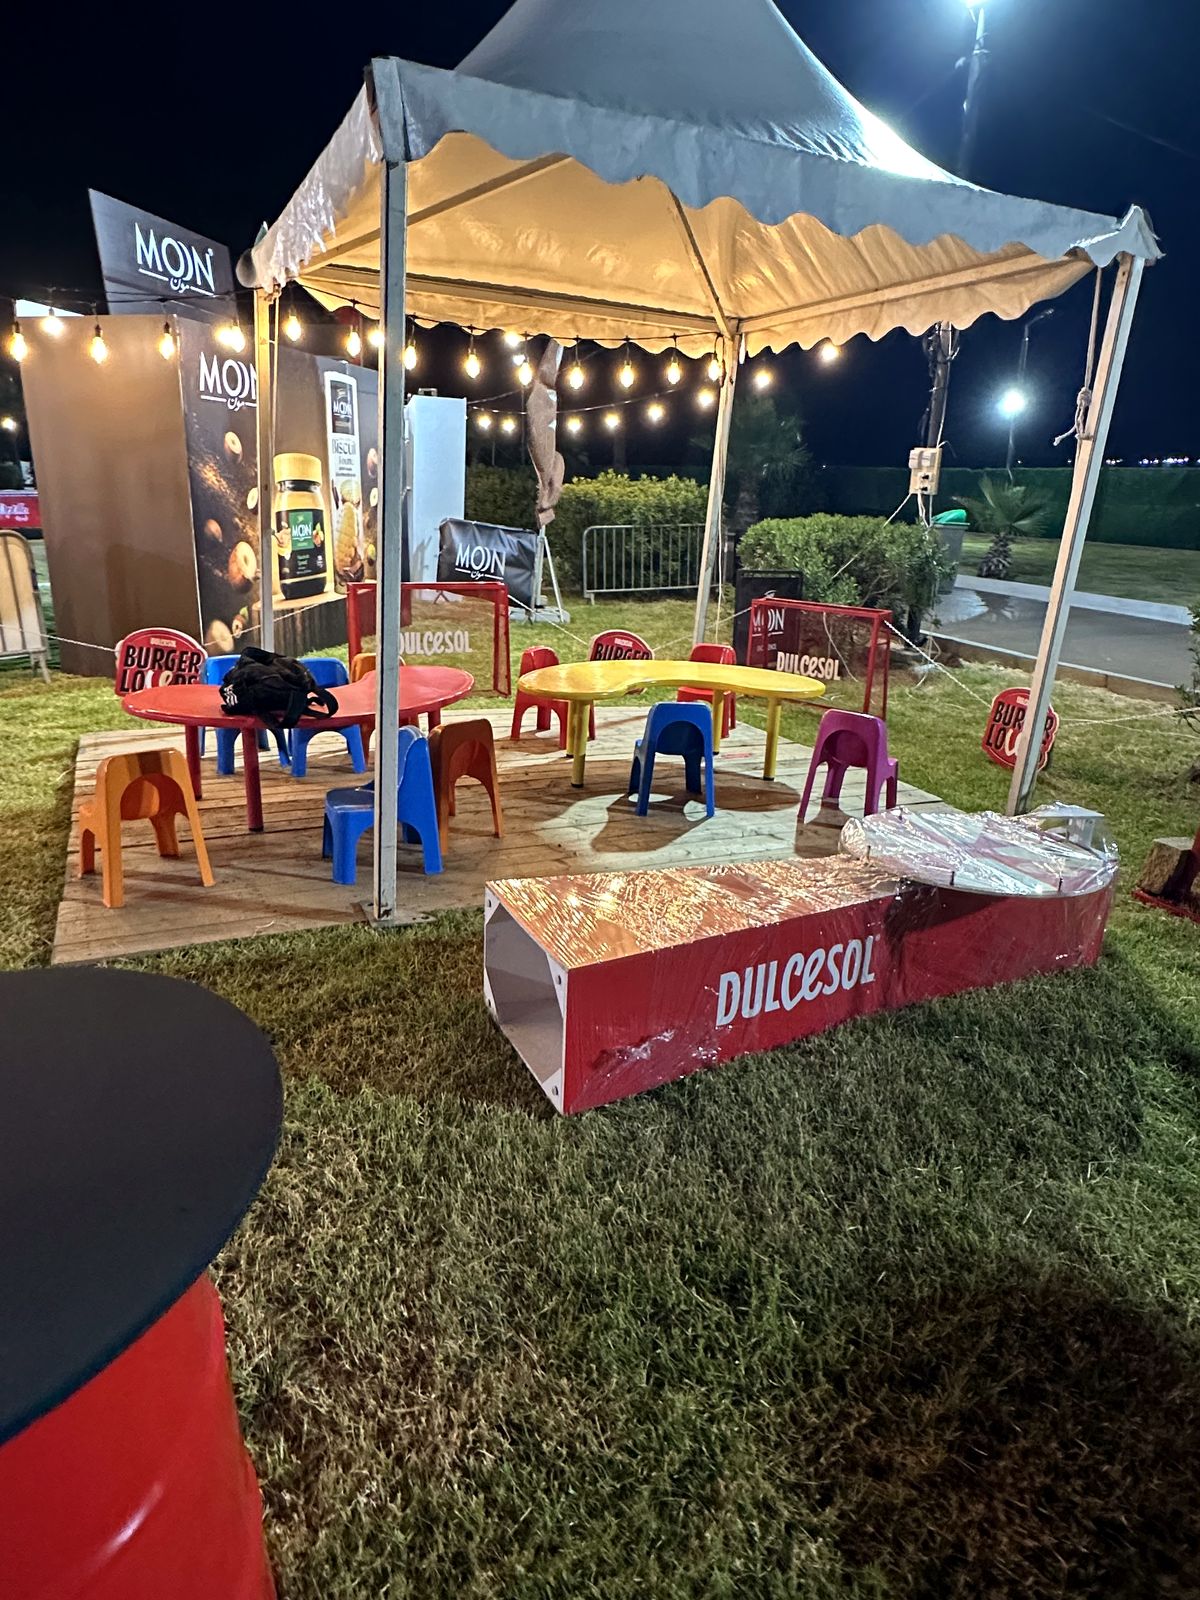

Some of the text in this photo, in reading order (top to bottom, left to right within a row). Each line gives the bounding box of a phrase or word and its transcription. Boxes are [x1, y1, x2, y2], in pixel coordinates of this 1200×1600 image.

[134, 222, 215, 292] MOON
[455, 543, 506, 576] MOON
[752, 608, 785, 632] MON
[123, 644, 202, 674] BURGER
[992, 700, 1054, 741] BURR
